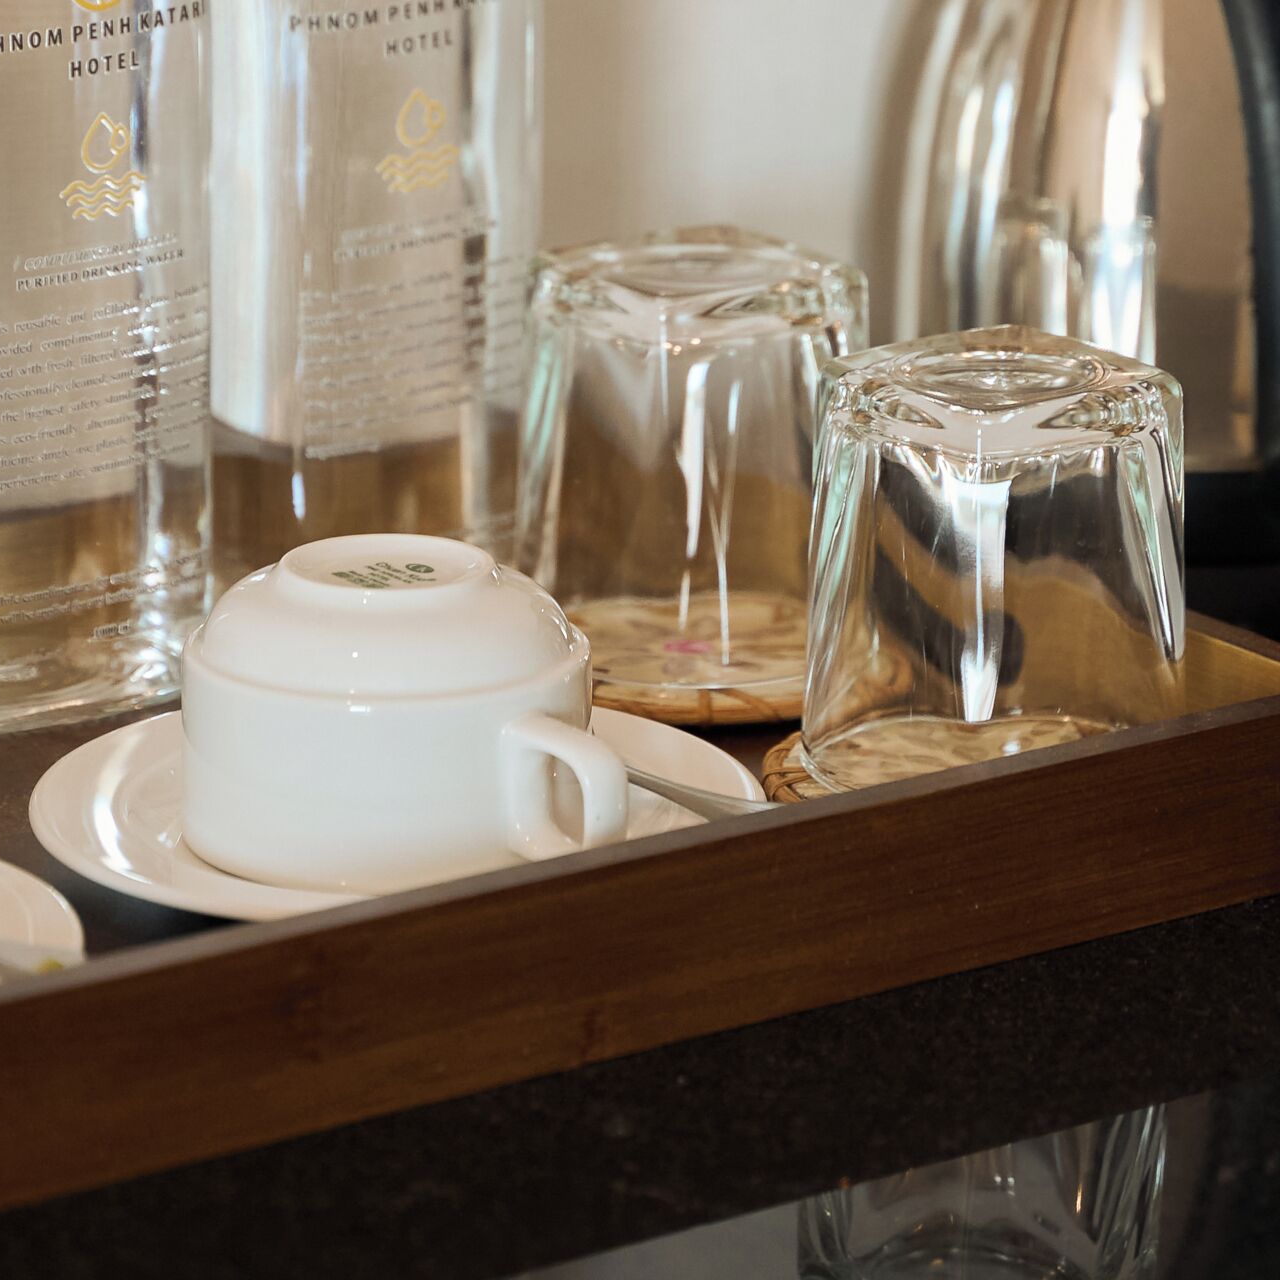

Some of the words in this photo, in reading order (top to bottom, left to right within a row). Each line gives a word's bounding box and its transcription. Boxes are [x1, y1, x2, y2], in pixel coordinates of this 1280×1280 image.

[72, 17, 131, 43] PENH
[138, 0, 206, 32] KATARI
[289, 9, 379, 32] PHNOM
[386, 29, 453, 56] HOTEL
[69, 50, 141, 80] HOTEL
[16, 271, 78, 291] PURIFIED
[80, 259, 142, 280] DRINKING
[15, 314, 60, 332] reusable
[16, 361, 41, 377] with
[79, 347, 115, 364] filtered
[0, 410, 18, 424] the
[23, 403, 64, 423] highest
[68, 397, 97, 412] safety
[12, 424, 76, 445] eco-friendly
